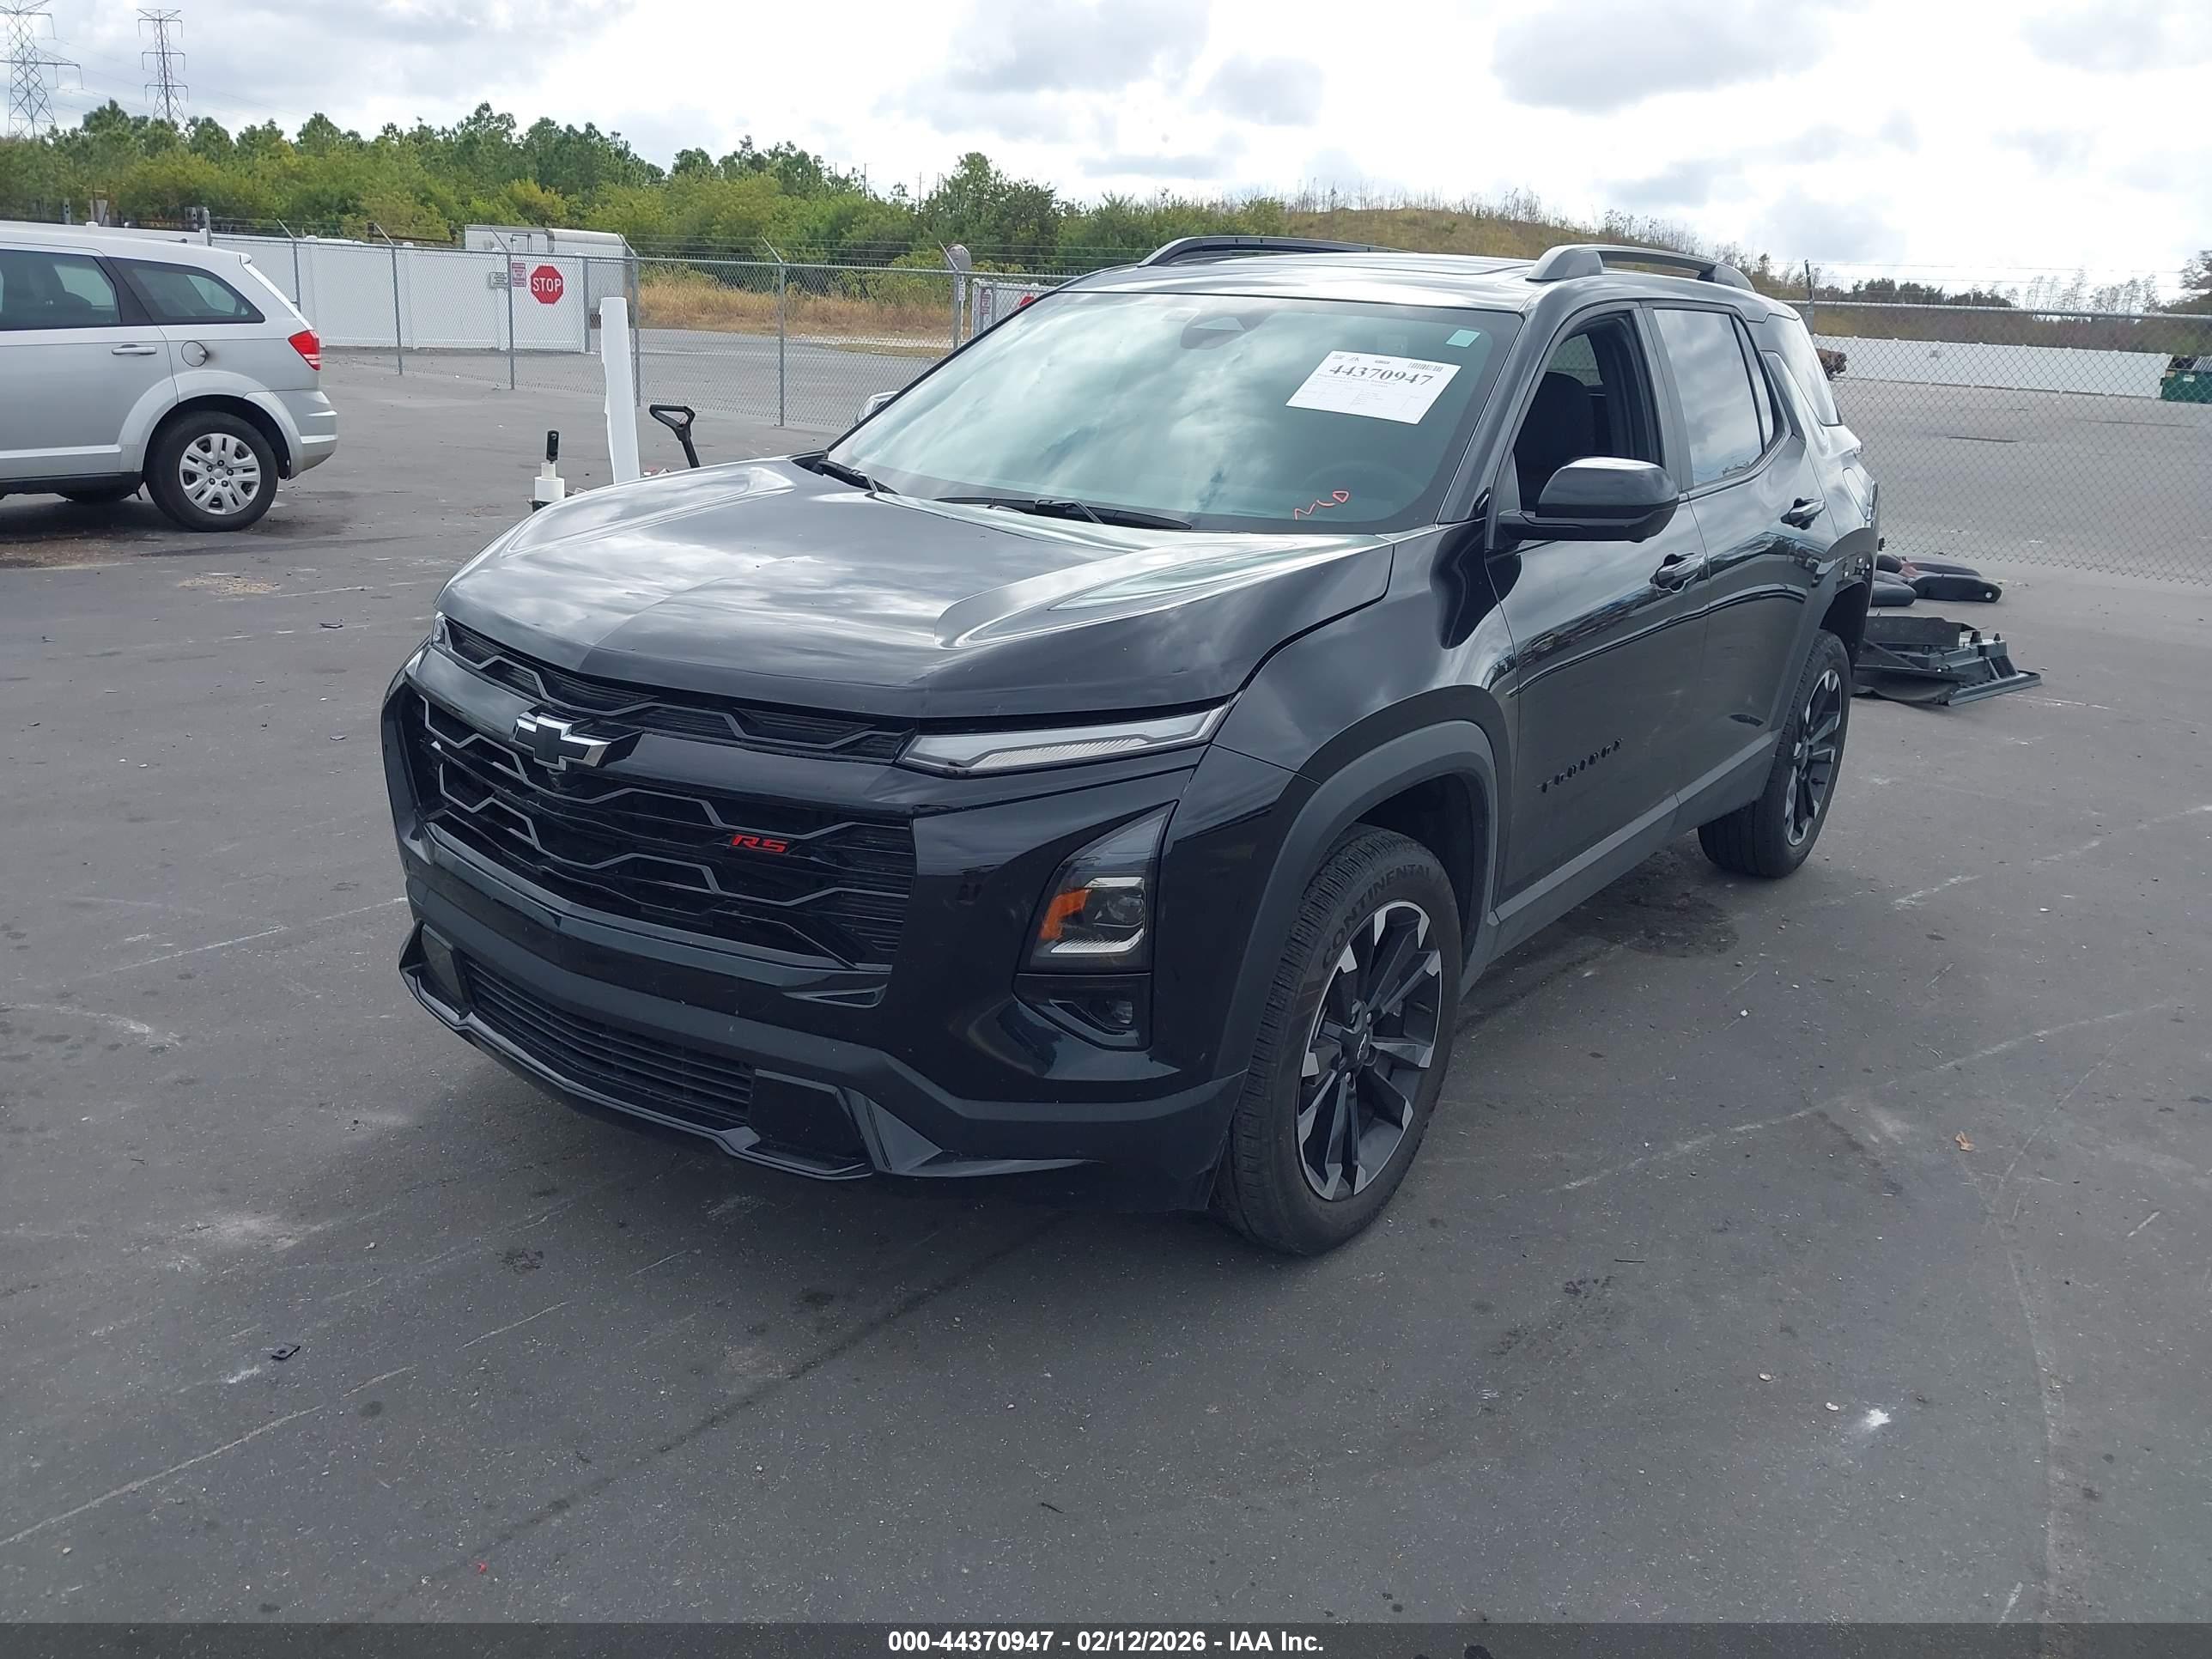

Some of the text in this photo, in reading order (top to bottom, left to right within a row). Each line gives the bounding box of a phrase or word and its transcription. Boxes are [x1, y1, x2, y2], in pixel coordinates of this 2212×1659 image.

[532, 277, 562, 292] STOP
[1329, 364, 1435, 386] 44370947
[731, 834, 790, 853] RS
[1322, 864, 1431, 969] CONTINENTAL
